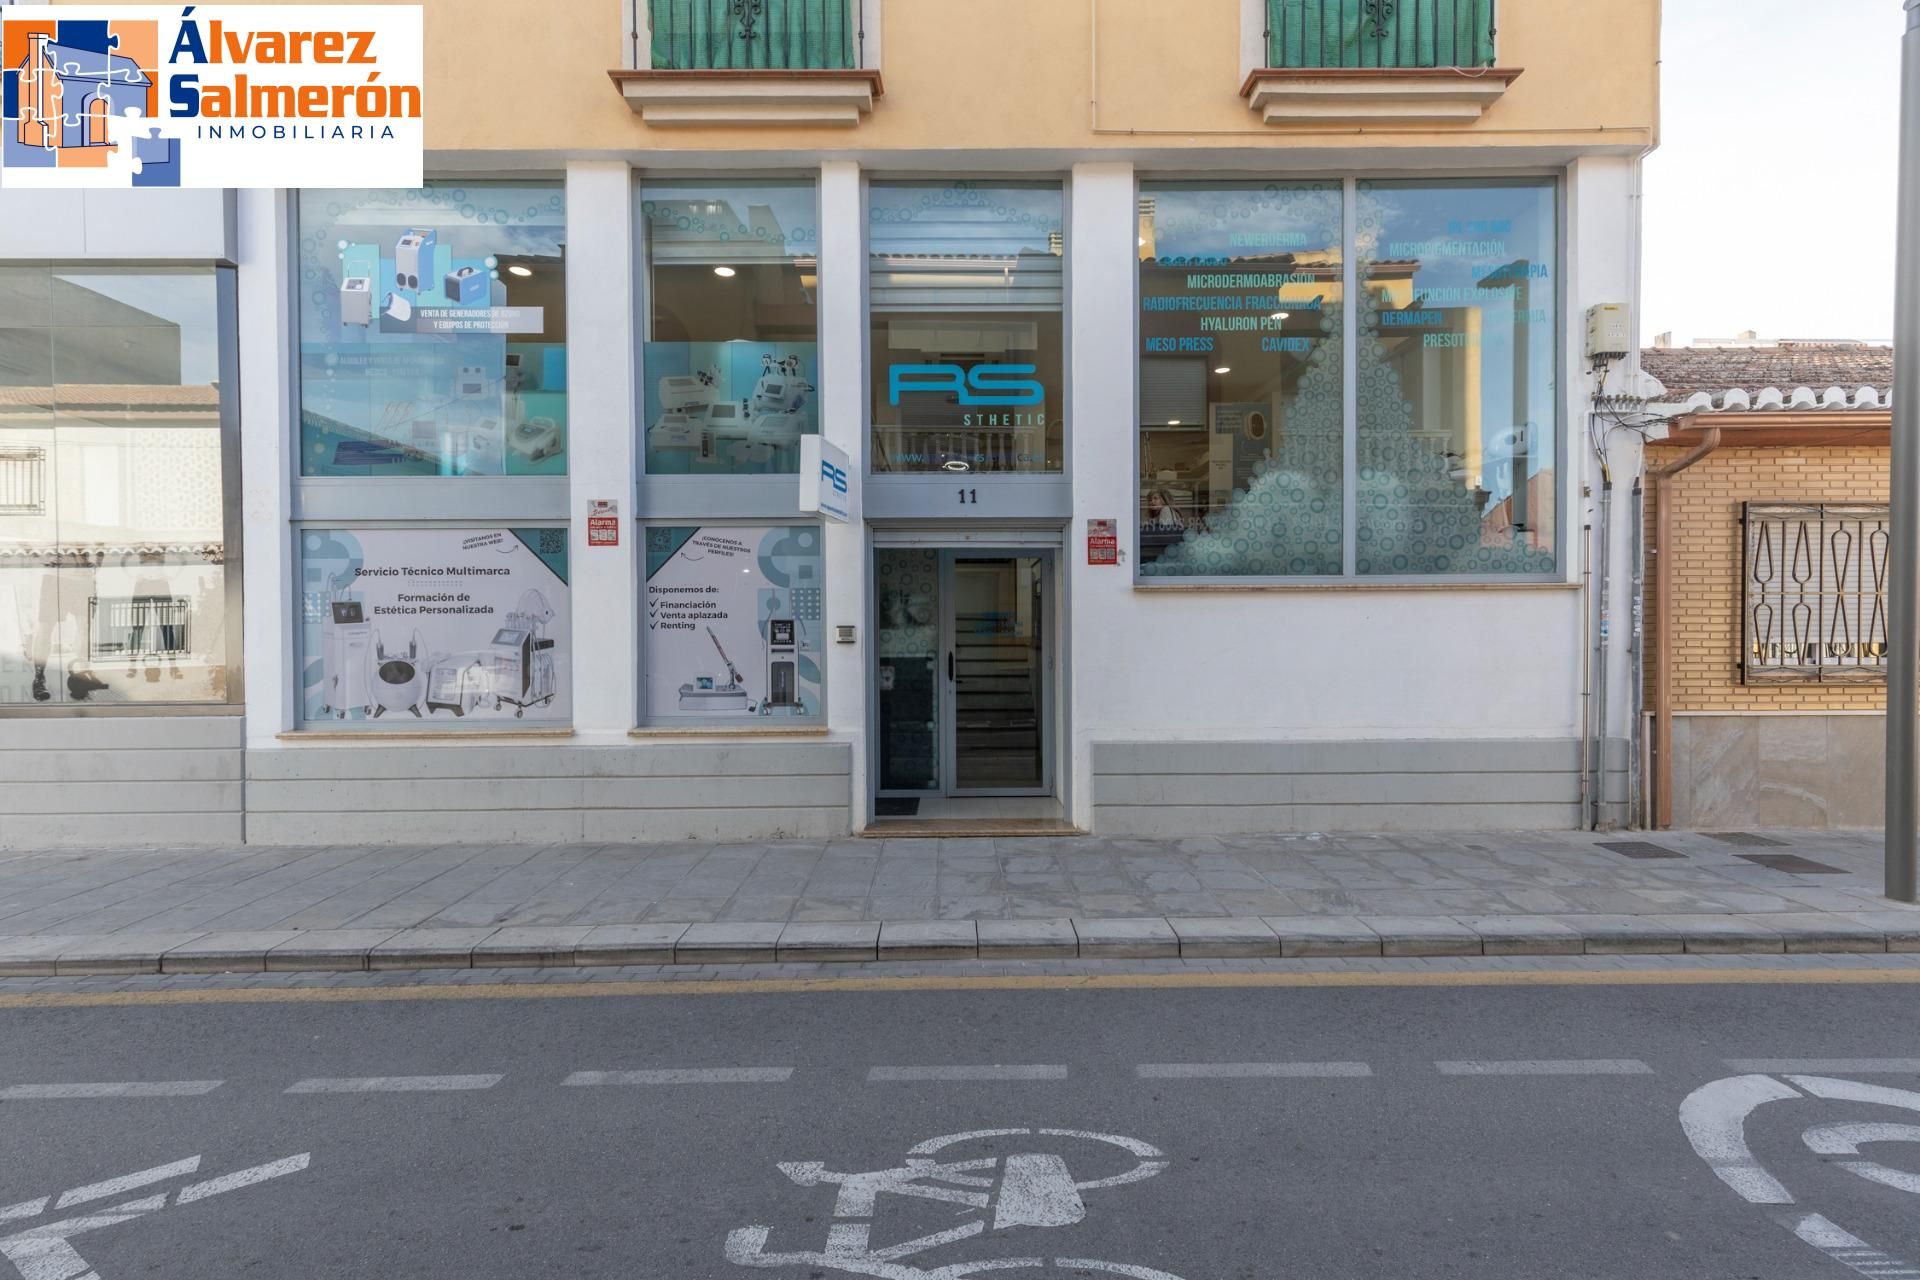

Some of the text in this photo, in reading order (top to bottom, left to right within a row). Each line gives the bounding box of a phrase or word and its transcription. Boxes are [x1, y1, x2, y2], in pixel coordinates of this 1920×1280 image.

[1200, 316, 1281, 331] HYALURON PEN
[1145, 337, 1214, 351] MESO PRESS
[888, 364, 1045, 406] RS
[963, 414, 1045, 426] STHETIC
[958, 489, 977, 504] 11
[354, 566, 510, 576] Servicio Técnico Multimarca
[648, 585, 719, 594] Disponemos de:
[397, 592, 470, 602] Formación de
[660, 600, 716, 609] Financiación
[374, 605, 494, 615] Estética Personalizada
[687, 611, 728, 621] aplazada
[660, 622, 696, 631] Renting
